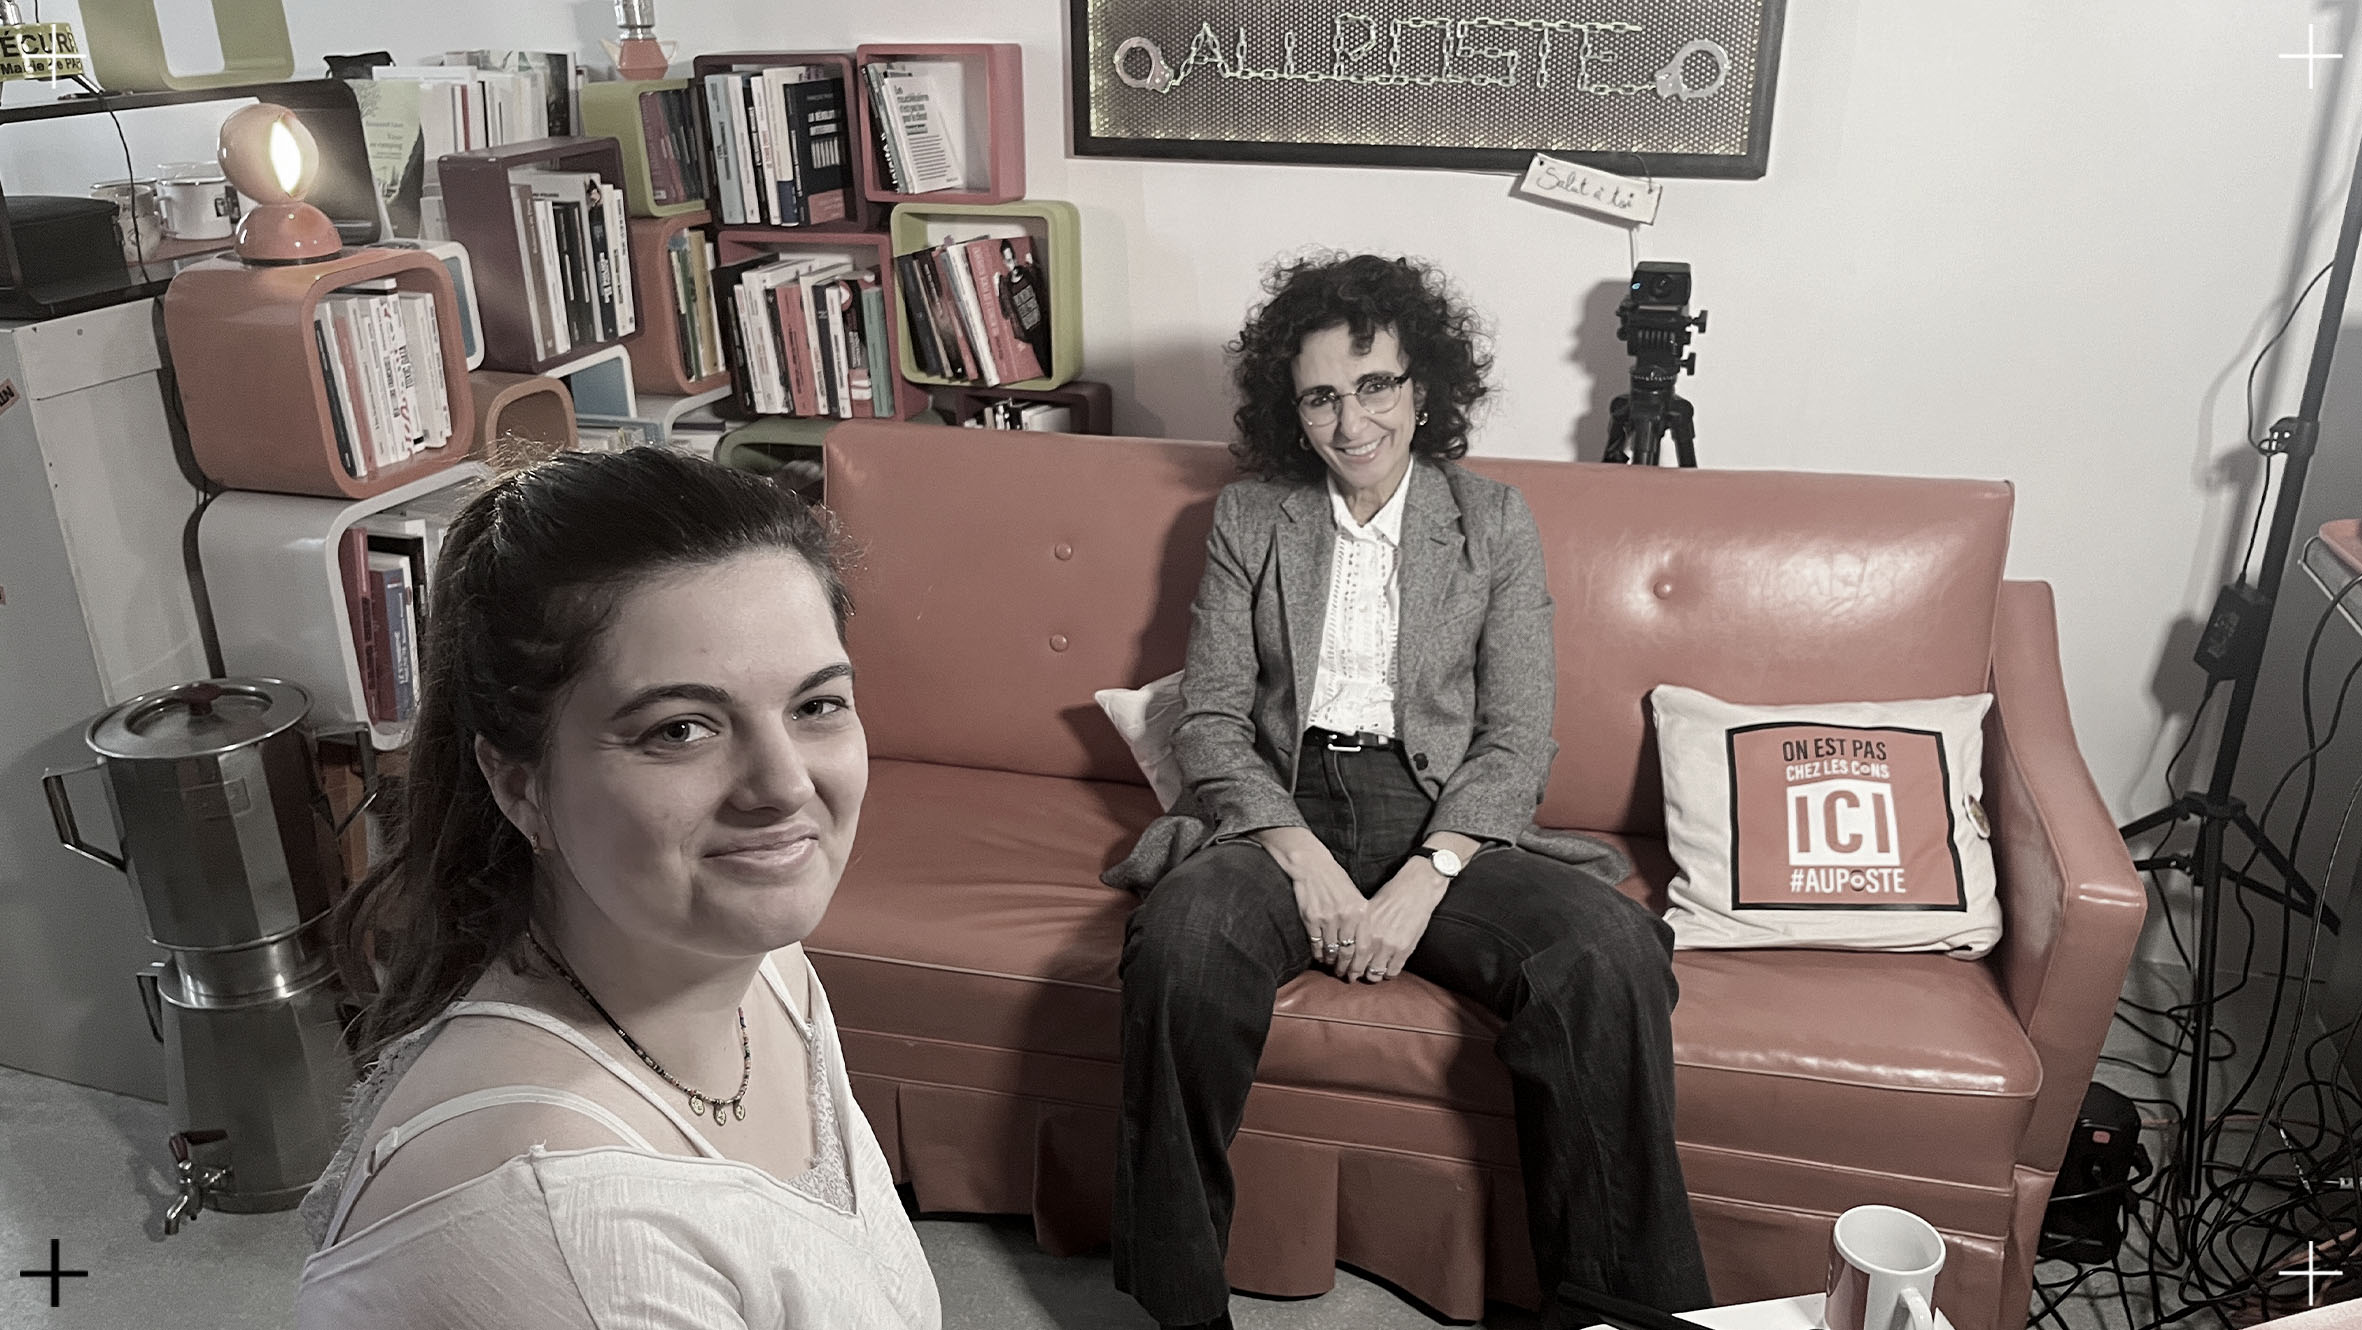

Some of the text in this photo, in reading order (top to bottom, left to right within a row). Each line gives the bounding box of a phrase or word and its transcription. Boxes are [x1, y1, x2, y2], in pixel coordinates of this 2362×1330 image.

[1536, 167, 1590, 196] Salut
[1609, 186, 1635, 209] toi
[1783, 737, 1888, 761] ON EST PAS
[1786, 759, 1891, 782] CHEZ LES CONS
[1795, 789, 1891, 854] ICI
[1790, 868, 1907, 893] #AUPOSTE
